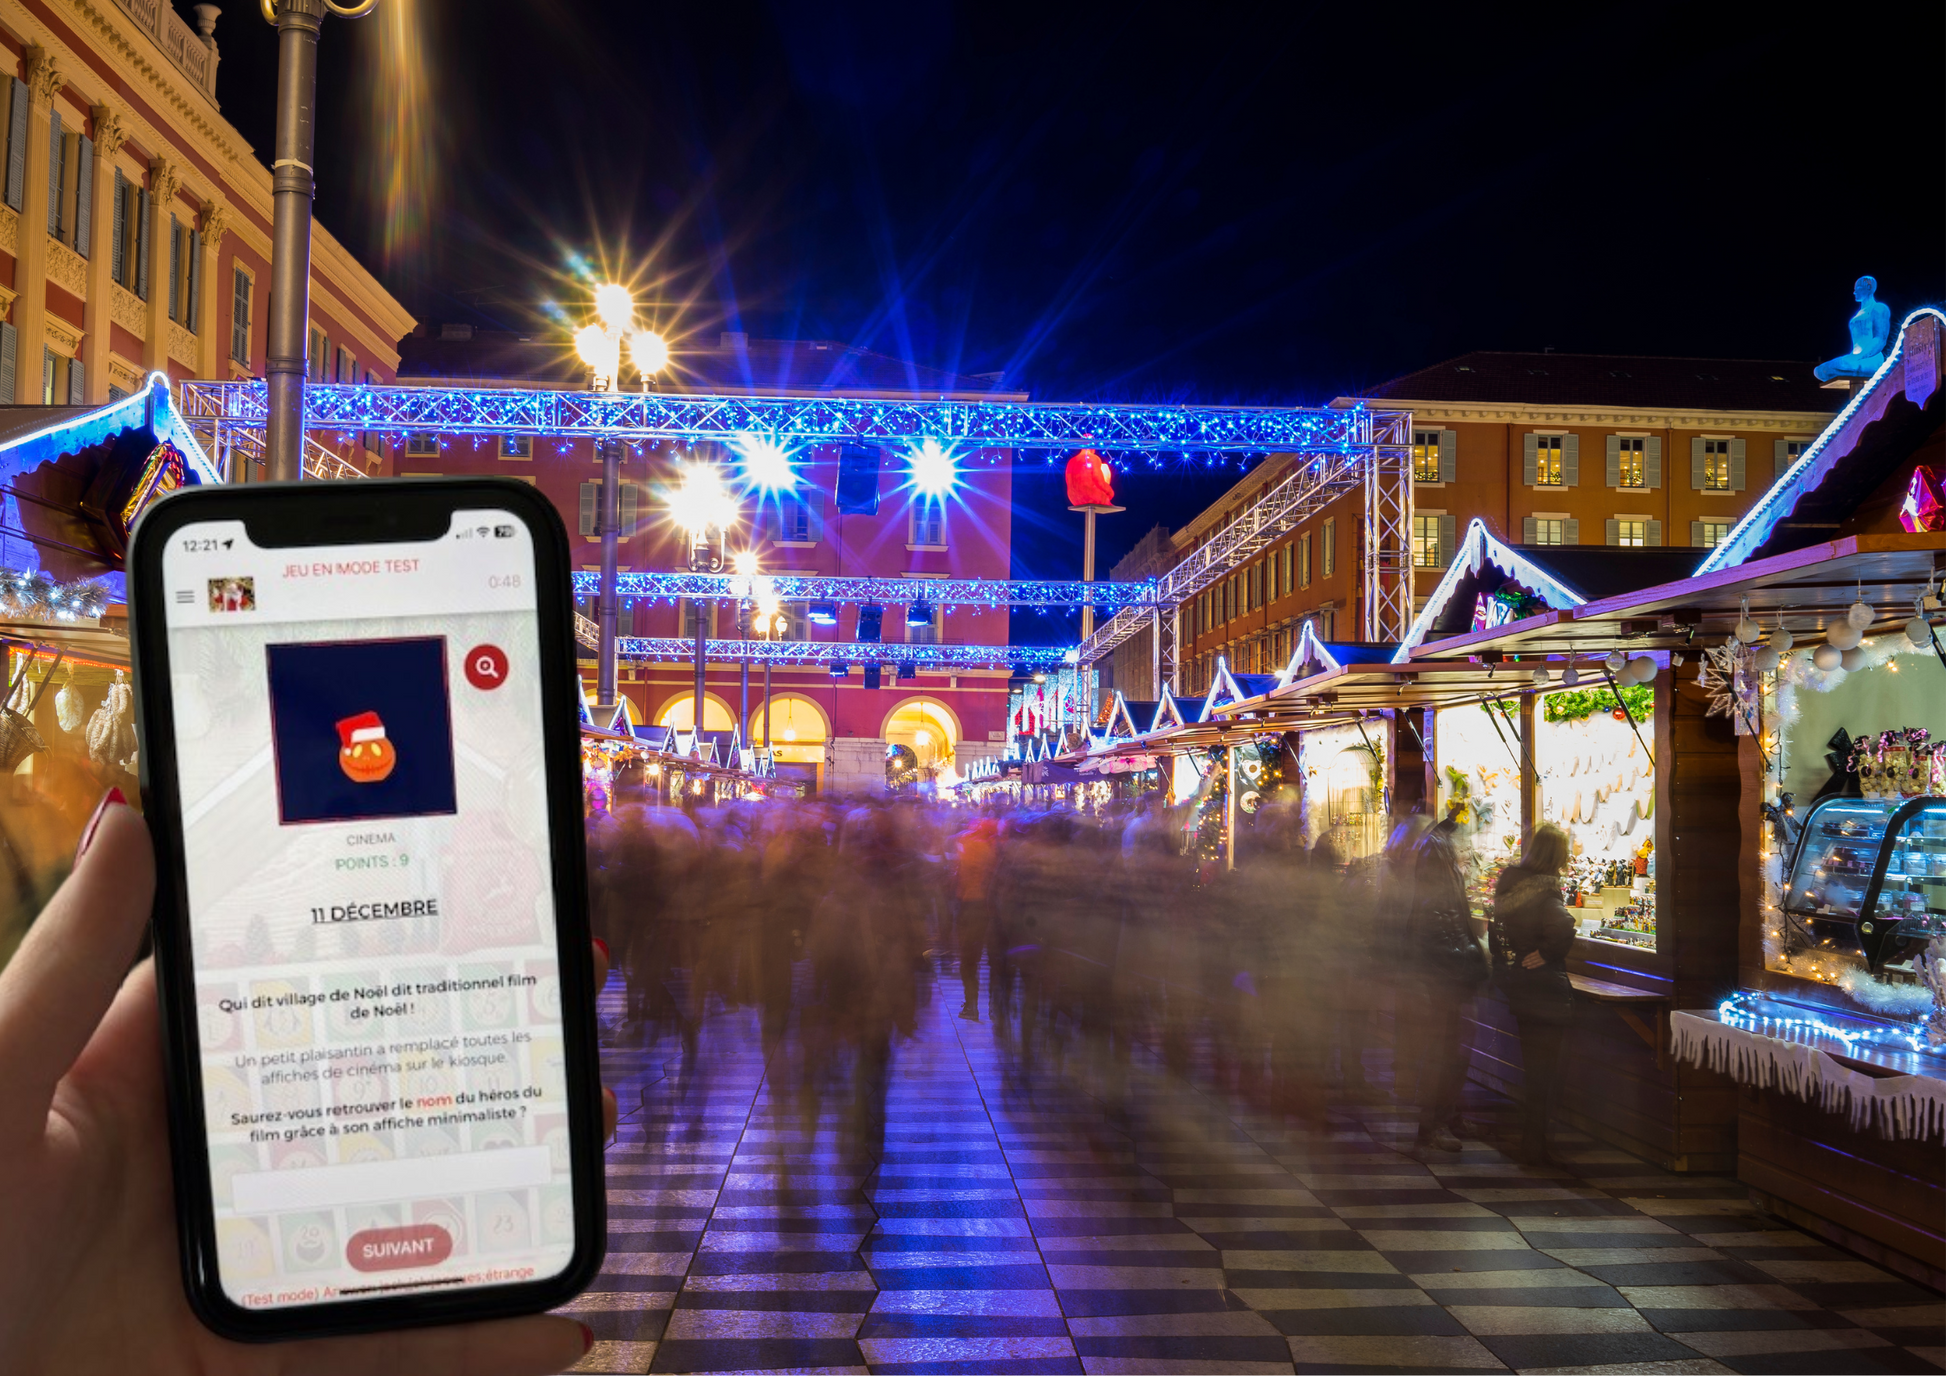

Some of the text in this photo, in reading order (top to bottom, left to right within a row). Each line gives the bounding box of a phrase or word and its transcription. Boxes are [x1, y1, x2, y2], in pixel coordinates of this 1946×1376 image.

[182, 538, 218, 552] 12:21
[282, 558, 421, 579] JEU EN MODE TEST
[488, 573, 522, 589] 0:48
[346, 832, 397, 847] CINEMA
[335, 854, 389, 870] POINTS
[399, 852, 410, 867] 9
[311, 898, 438, 924] 11 DÉCEMBRE
[218, 973, 537, 1014] Qui dit village de Noël dit traditionnel film
[349, 1005, 370, 1020] de
[373, 1002, 408, 1018] Noël
[234, 1030, 532, 1069] Un petit plaisantin a remplacé toutes les
[260, 1068, 320, 1085] affiches
[322, 1066, 343, 1079] de
[346, 1061, 402, 1077] cinéma
[405, 1058, 428, 1072] sur
[431, 1057, 444, 1070] le
[230, 1085, 543, 1126] Saurez-vous retrouver le nom du héros du
[249, 1105, 528, 1143] film grâce à son affiche minimaliste ?
[362, 1236, 436, 1259] SUIVANT
[240, 1291, 274, 1307] (Test
[276, 1286, 320, 1302] mode)
